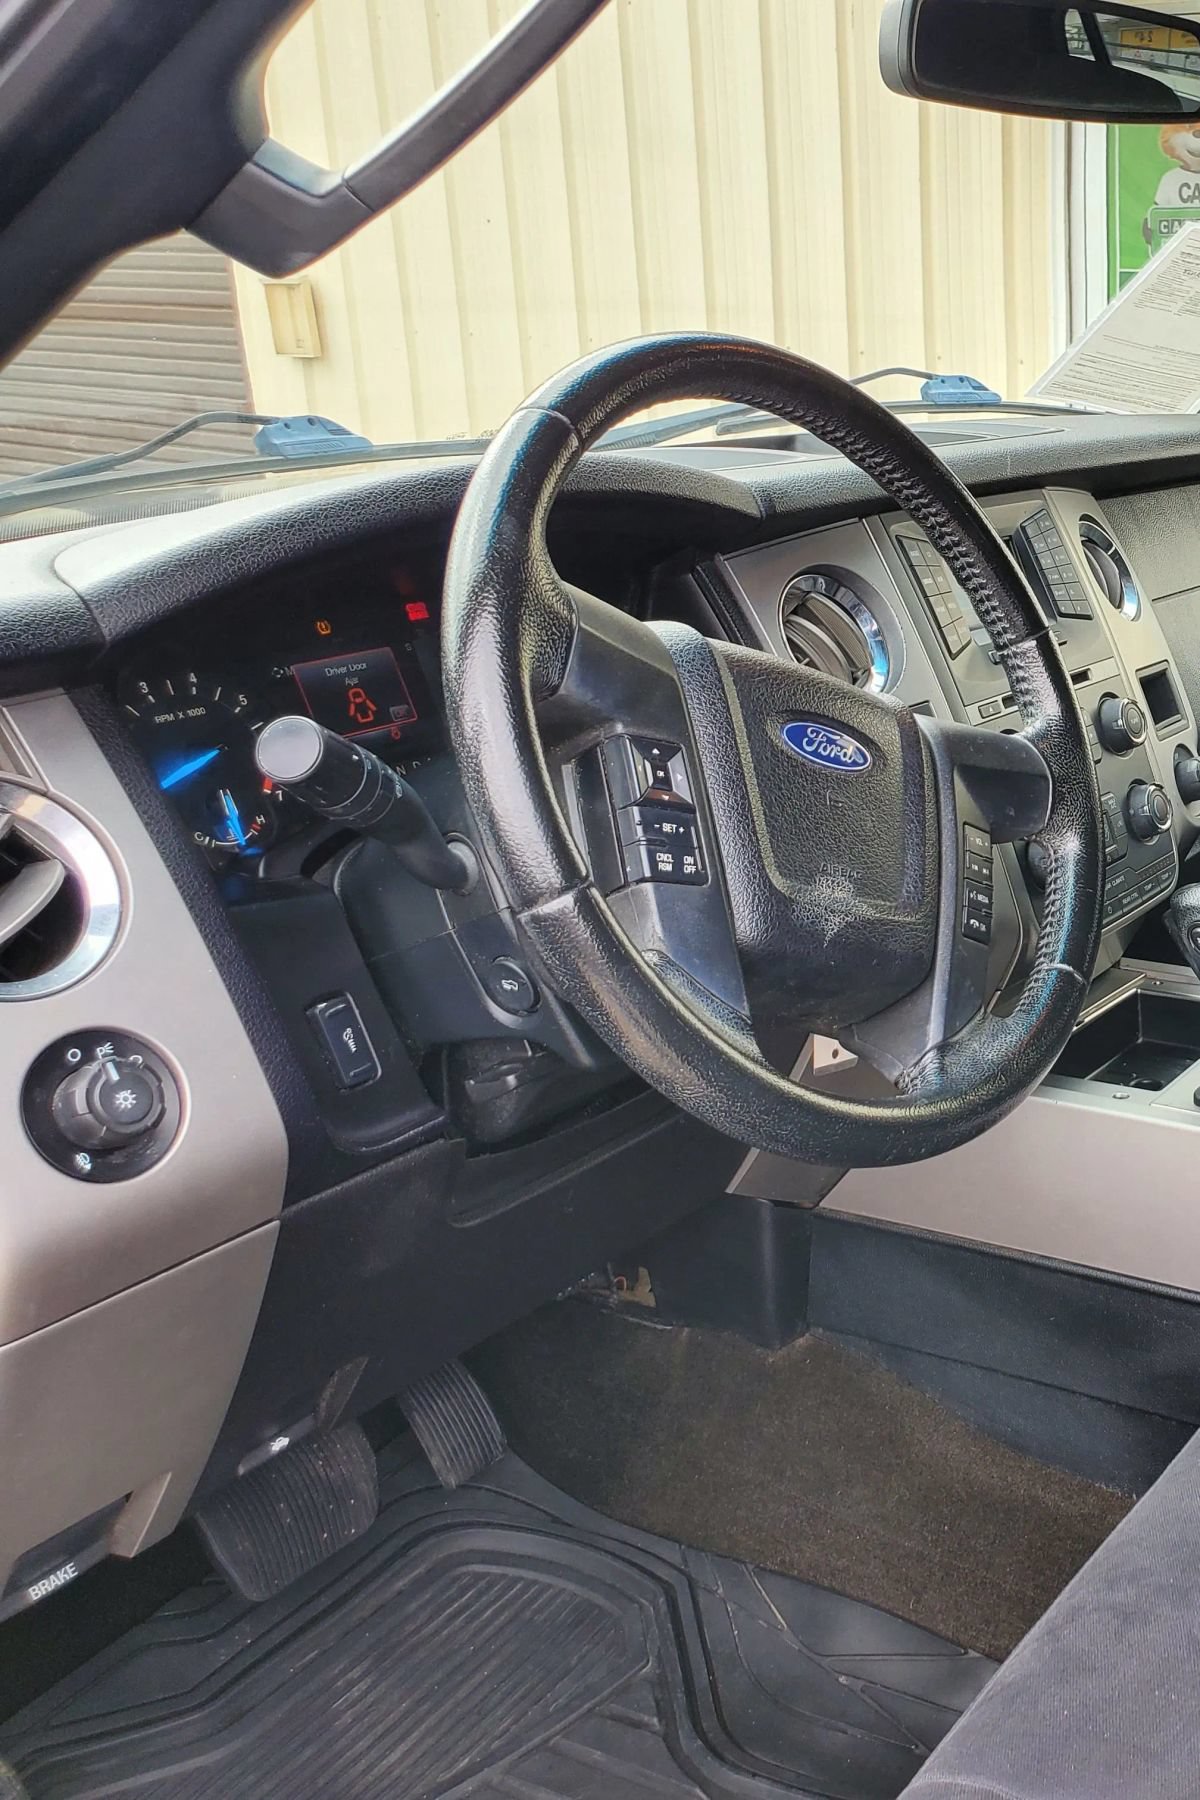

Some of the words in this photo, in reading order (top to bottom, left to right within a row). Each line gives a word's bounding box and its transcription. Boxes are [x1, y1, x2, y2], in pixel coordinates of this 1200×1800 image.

[325, 665, 347, 677] Driver
[349, 662, 367, 672] Door
[189, 672, 197, 684] 4
[139, 681, 149, 693] 3
[239, 694, 248, 705] 5
[154, 712, 175, 724] RPM
[187, 706, 206, 717] 1000
[802, 726, 860, 764] Ford
[275, 790, 283, 801] 7
[255, 814, 266, 824] H
[662, 823, 677, 833] SET
[194, 831, 204, 841] C
[656, 852, 674, 863] CNCL
[683, 856, 694, 865] ON
[658, 862, 672, 872] RSM
[683, 864, 697, 874] OFF
[28, 1562, 79, 1601] BRAKE
